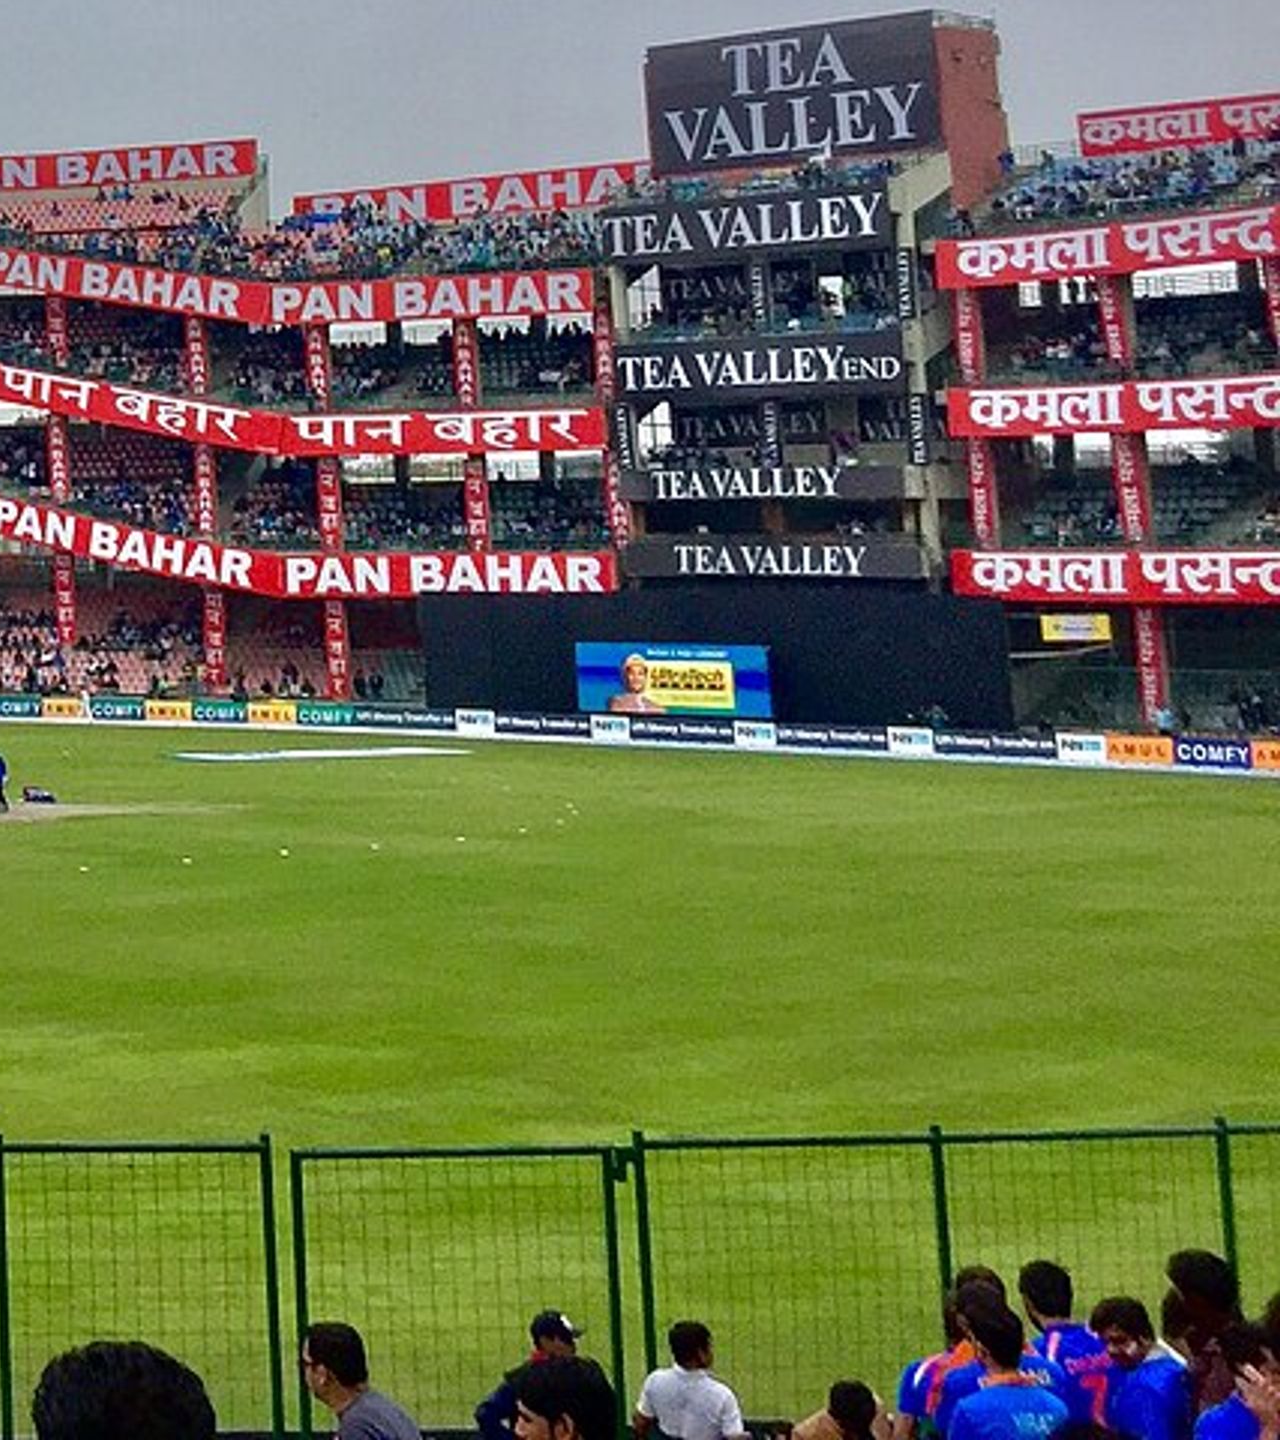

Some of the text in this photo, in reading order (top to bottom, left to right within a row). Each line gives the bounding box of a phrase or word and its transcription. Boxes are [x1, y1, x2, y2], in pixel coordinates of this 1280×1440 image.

[722, 32, 854, 97] TEA
[665, 82, 923, 162] VALLEY
[1084, 112, 1210, 145] कमला
[57, 145, 239, 186] BAHAR
[603, 192, 884, 258] TEA VALLEY
[956, 208, 1278, 278] कमला पसन्द
[81, 262, 242, 319] BAHAR
[271, 274, 582, 321] PAN BAHAR
[617, 344, 900, 392] TEA VALLEY END
[0, 364, 253, 442] पान बहार
[969, 386, 1125, 428] कमला
[291, 409, 589, 449] पान बहार
[651, 465, 842, 500] TEA VALLEY
[89, 522, 252, 589] BAHAR
[285, 556, 604, 594] PAN BAHAR
[674, 544, 867, 578] TEA VALLEY
[971, 550, 1129, 594] कमला
[194, 704, 245, 720] COMFY
[299, 708, 353, 724] COMFY
[1109, 744, 1167, 759] AMUL
[1177, 742, 1250, 766] COMFY
